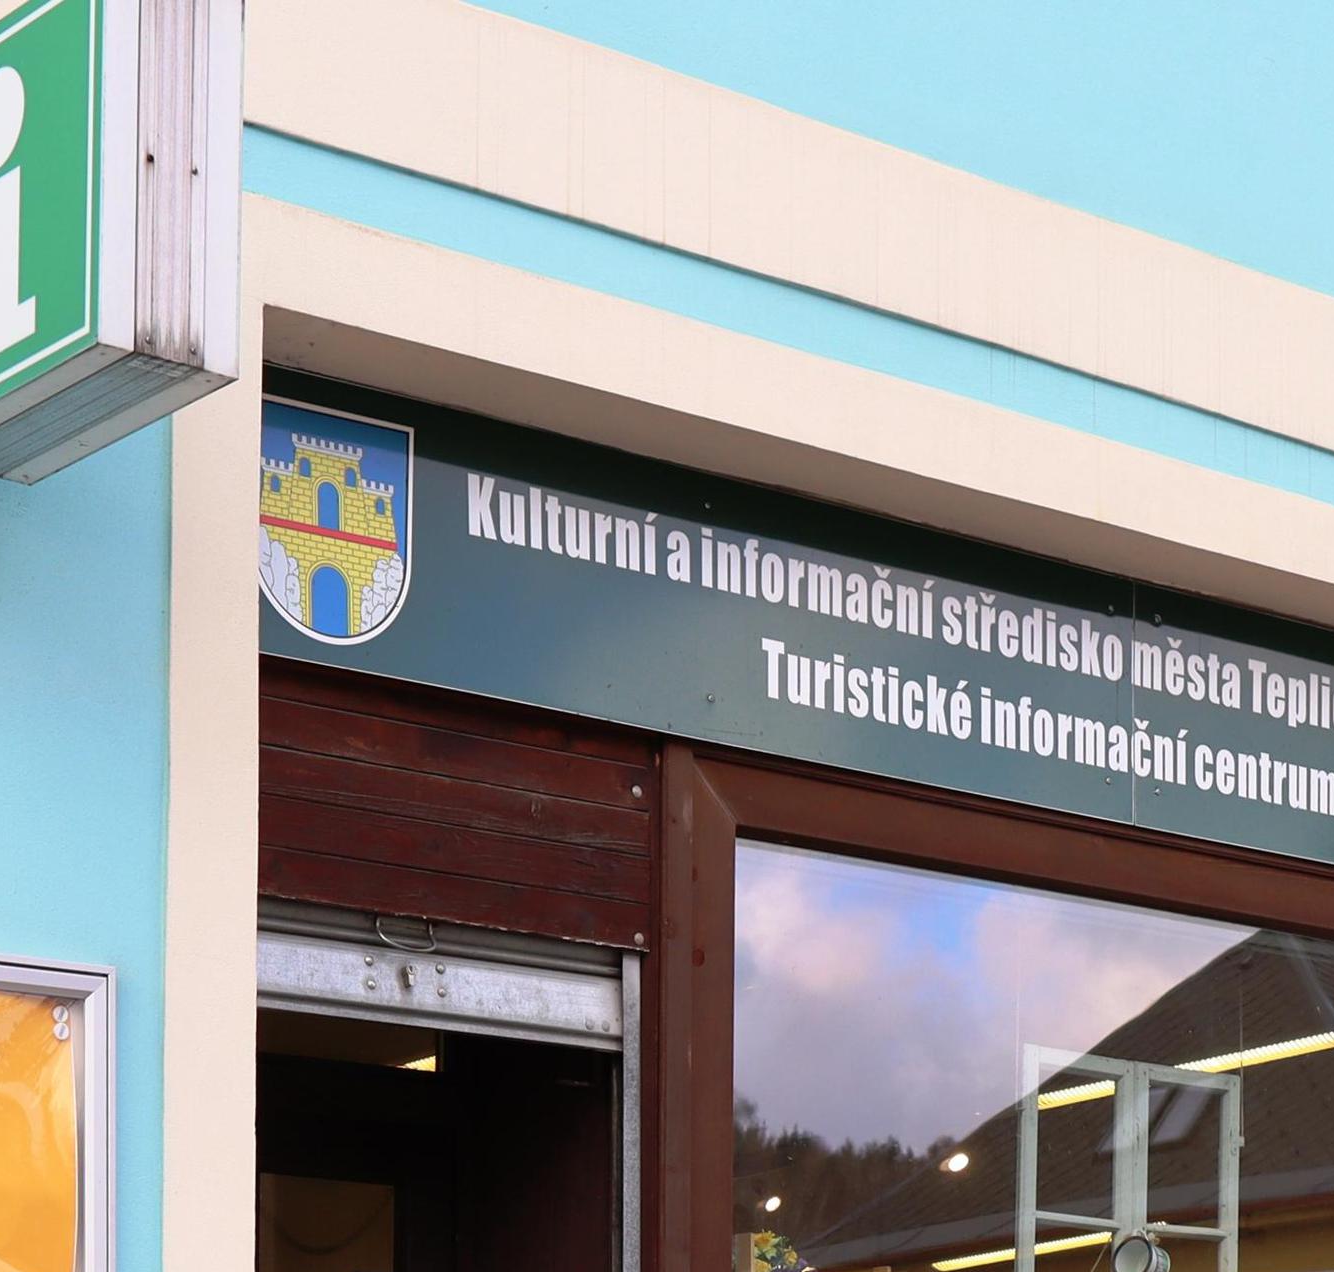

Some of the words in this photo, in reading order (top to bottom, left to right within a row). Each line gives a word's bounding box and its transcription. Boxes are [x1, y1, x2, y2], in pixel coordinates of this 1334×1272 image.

[466, 471, 659, 577] Kulturní
[666, 529, 691, 584] a
[700, 526, 934, 640] informační
[941, 592, 1124, 682] středisko
[1129, 636, 1241, 711] města
[761, 636, 972, 741] Turistické
[980, 686, 1188, 786] informační
